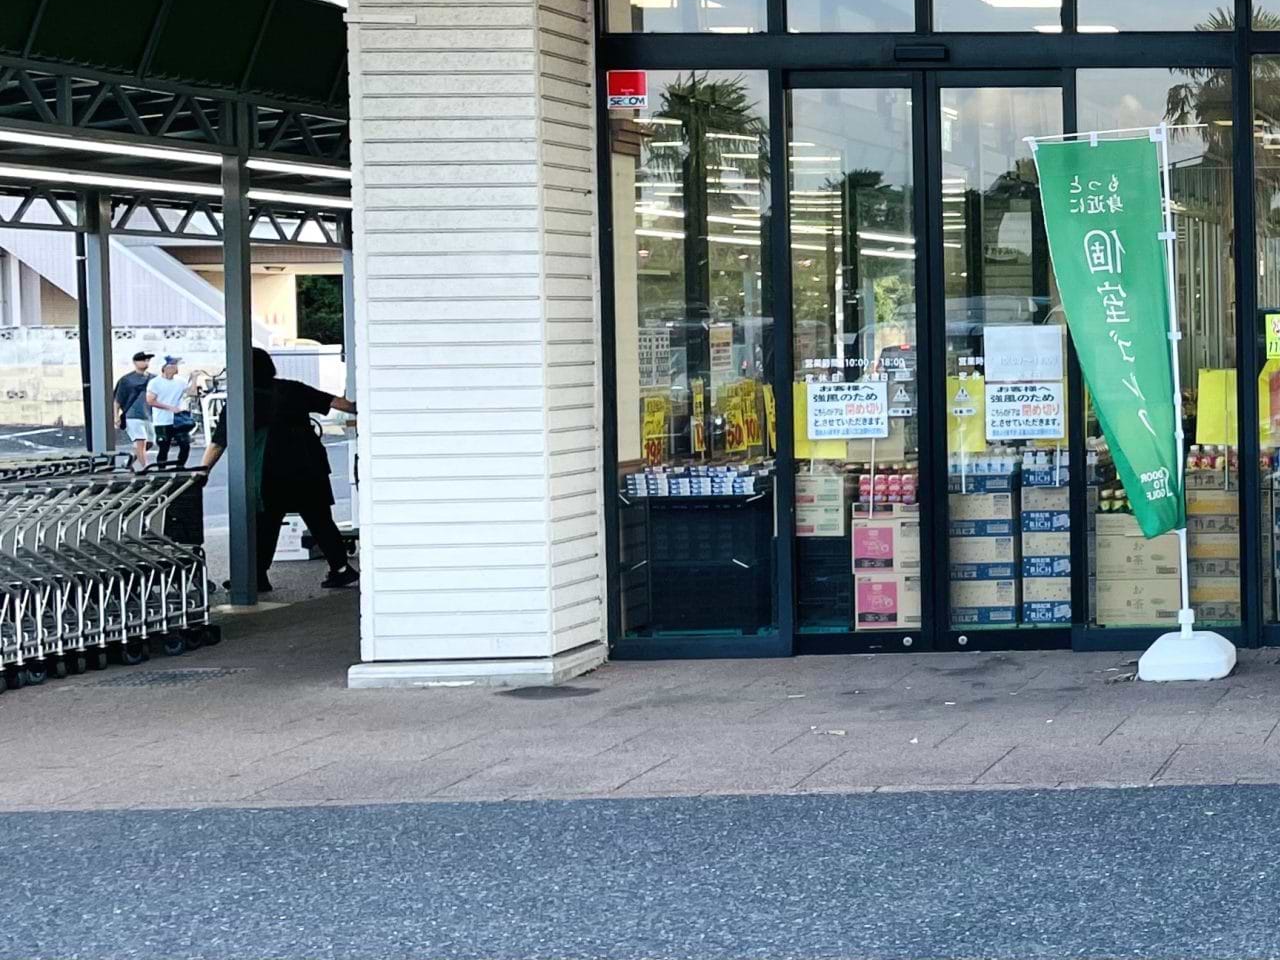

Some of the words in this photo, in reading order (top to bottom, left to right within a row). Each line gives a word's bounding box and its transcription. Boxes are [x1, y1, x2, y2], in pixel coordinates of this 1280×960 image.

[610, 96, 645, 106] SECOM
[819, 384, 875, 393] お客様へ
[996, 385, 1052, 393] お客様へ
[812, 392, 878, 402] 強風のため
[990, 394, 1055, 403] 強風のため
[845, 402, 883, 416] 閉め切り
[1021, 404, 1061, 416] 閉め切り
